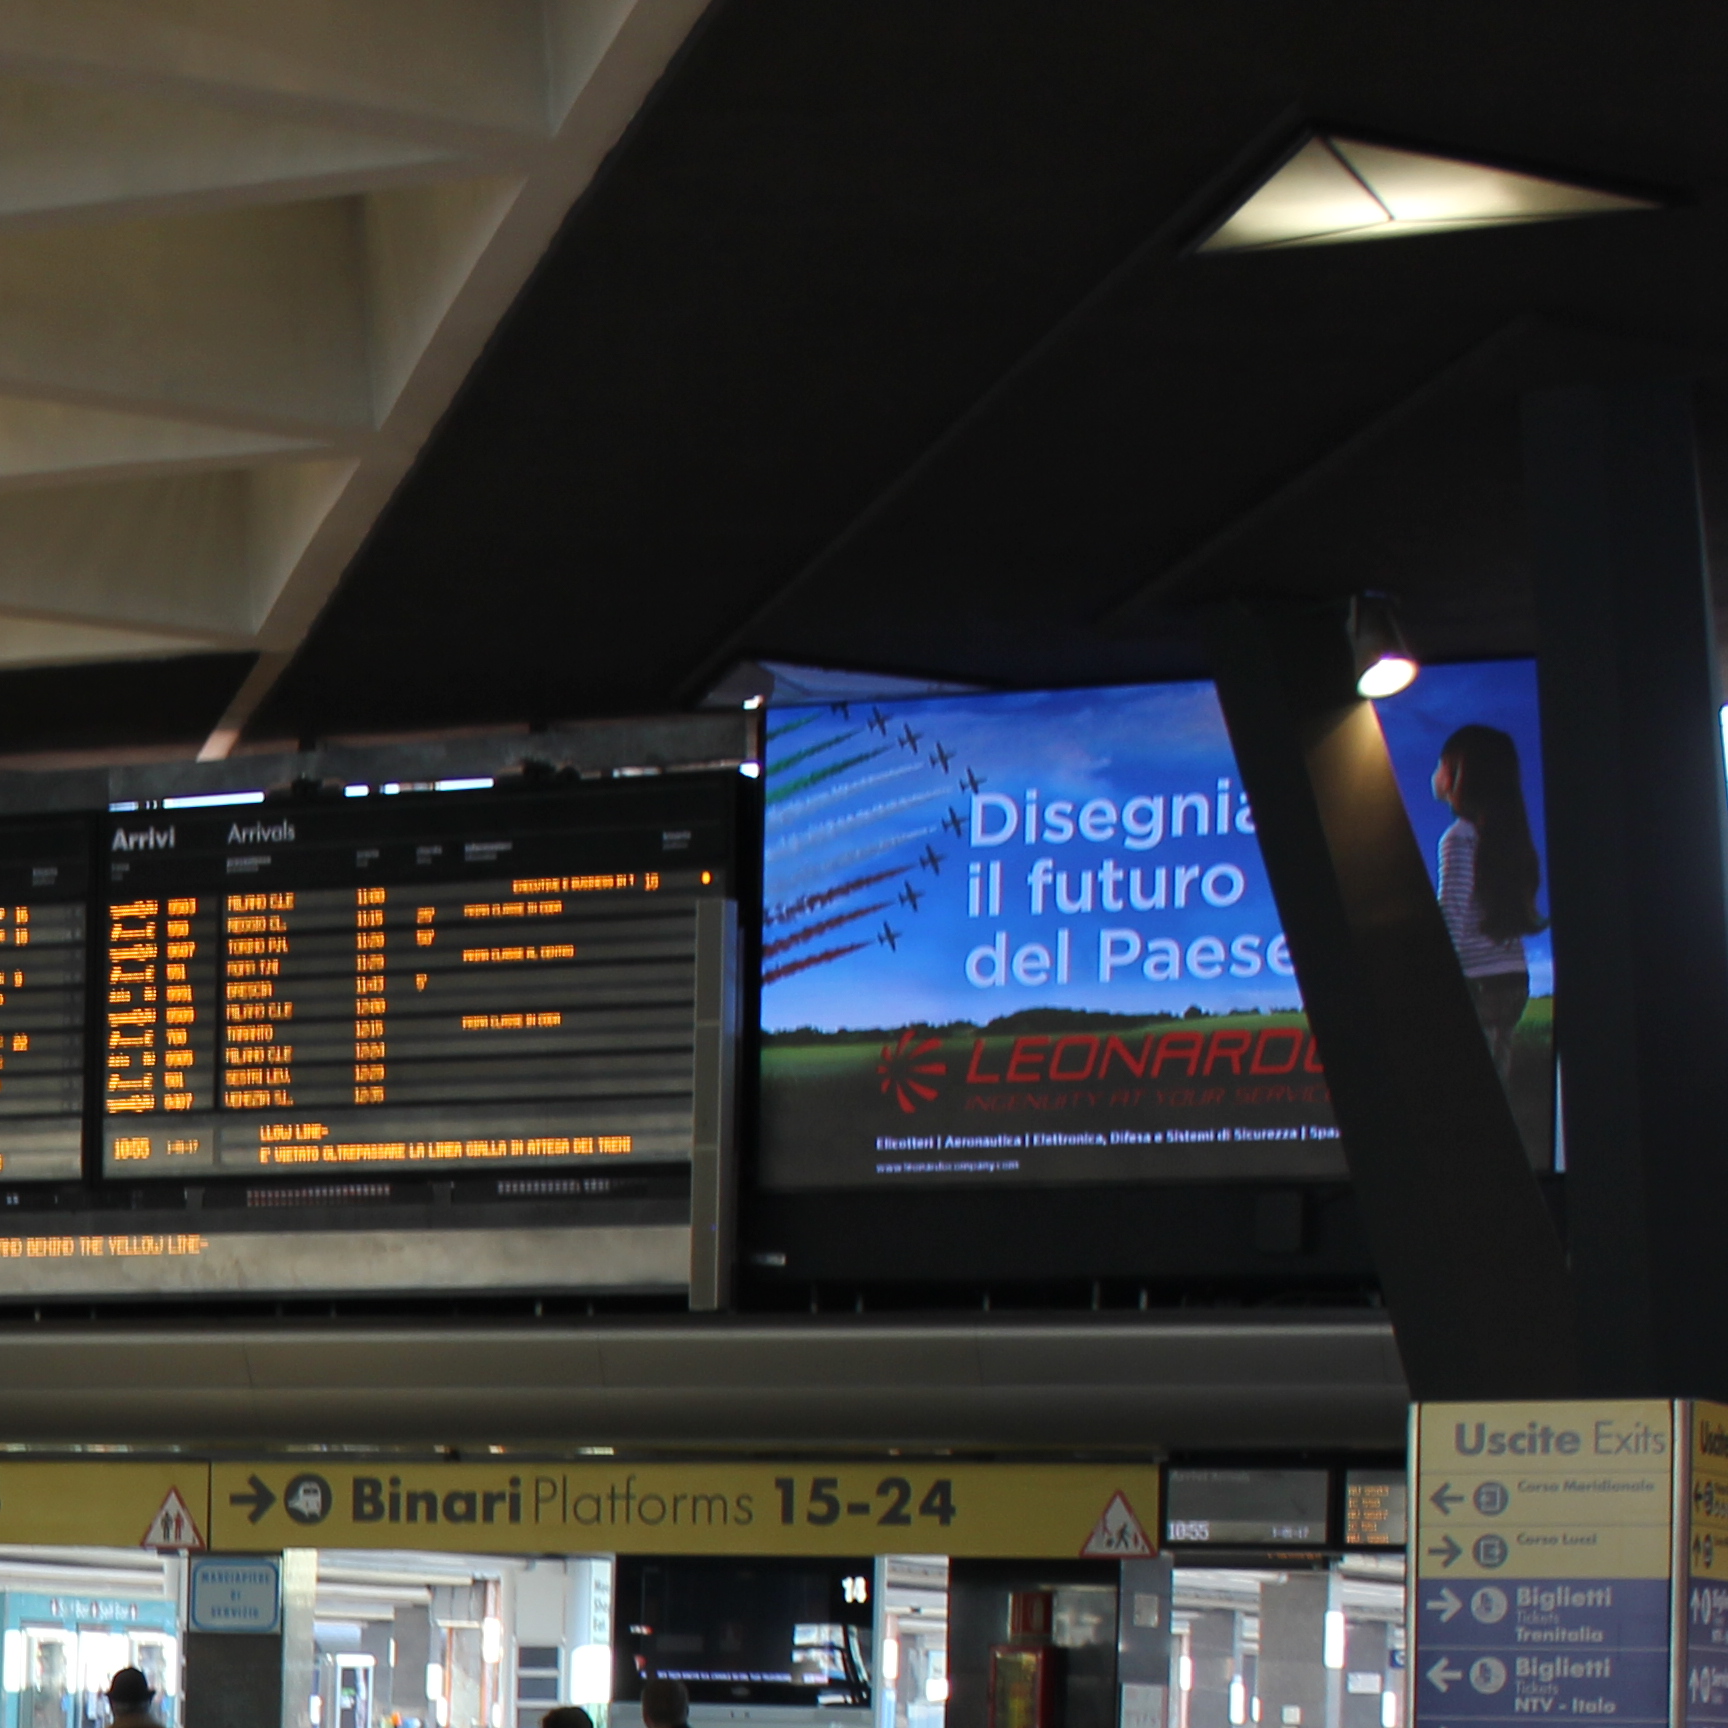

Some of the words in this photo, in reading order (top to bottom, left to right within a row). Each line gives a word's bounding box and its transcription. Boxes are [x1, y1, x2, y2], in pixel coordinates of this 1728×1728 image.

[111, 825, 175, 851] Arrivi
[227, 818, 295, 845] Arrivals
[968, 863, 1001, 916] il
[1028, 860, 1244, 914] futuro
[966, 929, 1068, 988] del
[26, 1236, 75, 1258] BEHIND
[79, 1236, 104, 1256] THE
[108, 1235, 164, 1256] YELLOW
[1454, 1421, 1582, 1457] Uscite
[1594, 1420, 1667, 1455] Exits
[1517, 1480, 1559, 1493] Corso
[1562, 1479, 1655, 1493] Meridionale
[351, 1474, 522, 1524] Binari
[533, 1475, 754, 1527] Platforms
[774, 1475, 957, 1527] 15-24
[1168, 1520, 1210, 1541] 10:55
[1517, 1533, 1558, 1546] Corso
[1562, 1532, 1597, 1546] Lucci
[1515, 1585, 1612, 1611] Biglietti
[1517, 1611, 1560, 1624] Tickets
[1515, 1627, 1604, 1643] Trenitalia
[1515, 1656, 1611, 1682] Biglietti
[1516, 1681, 1560, 1695] Tickets
[1514, 1698, 1554, 1713] NTV
[1572, 1697, 1616, 1715] Italo
